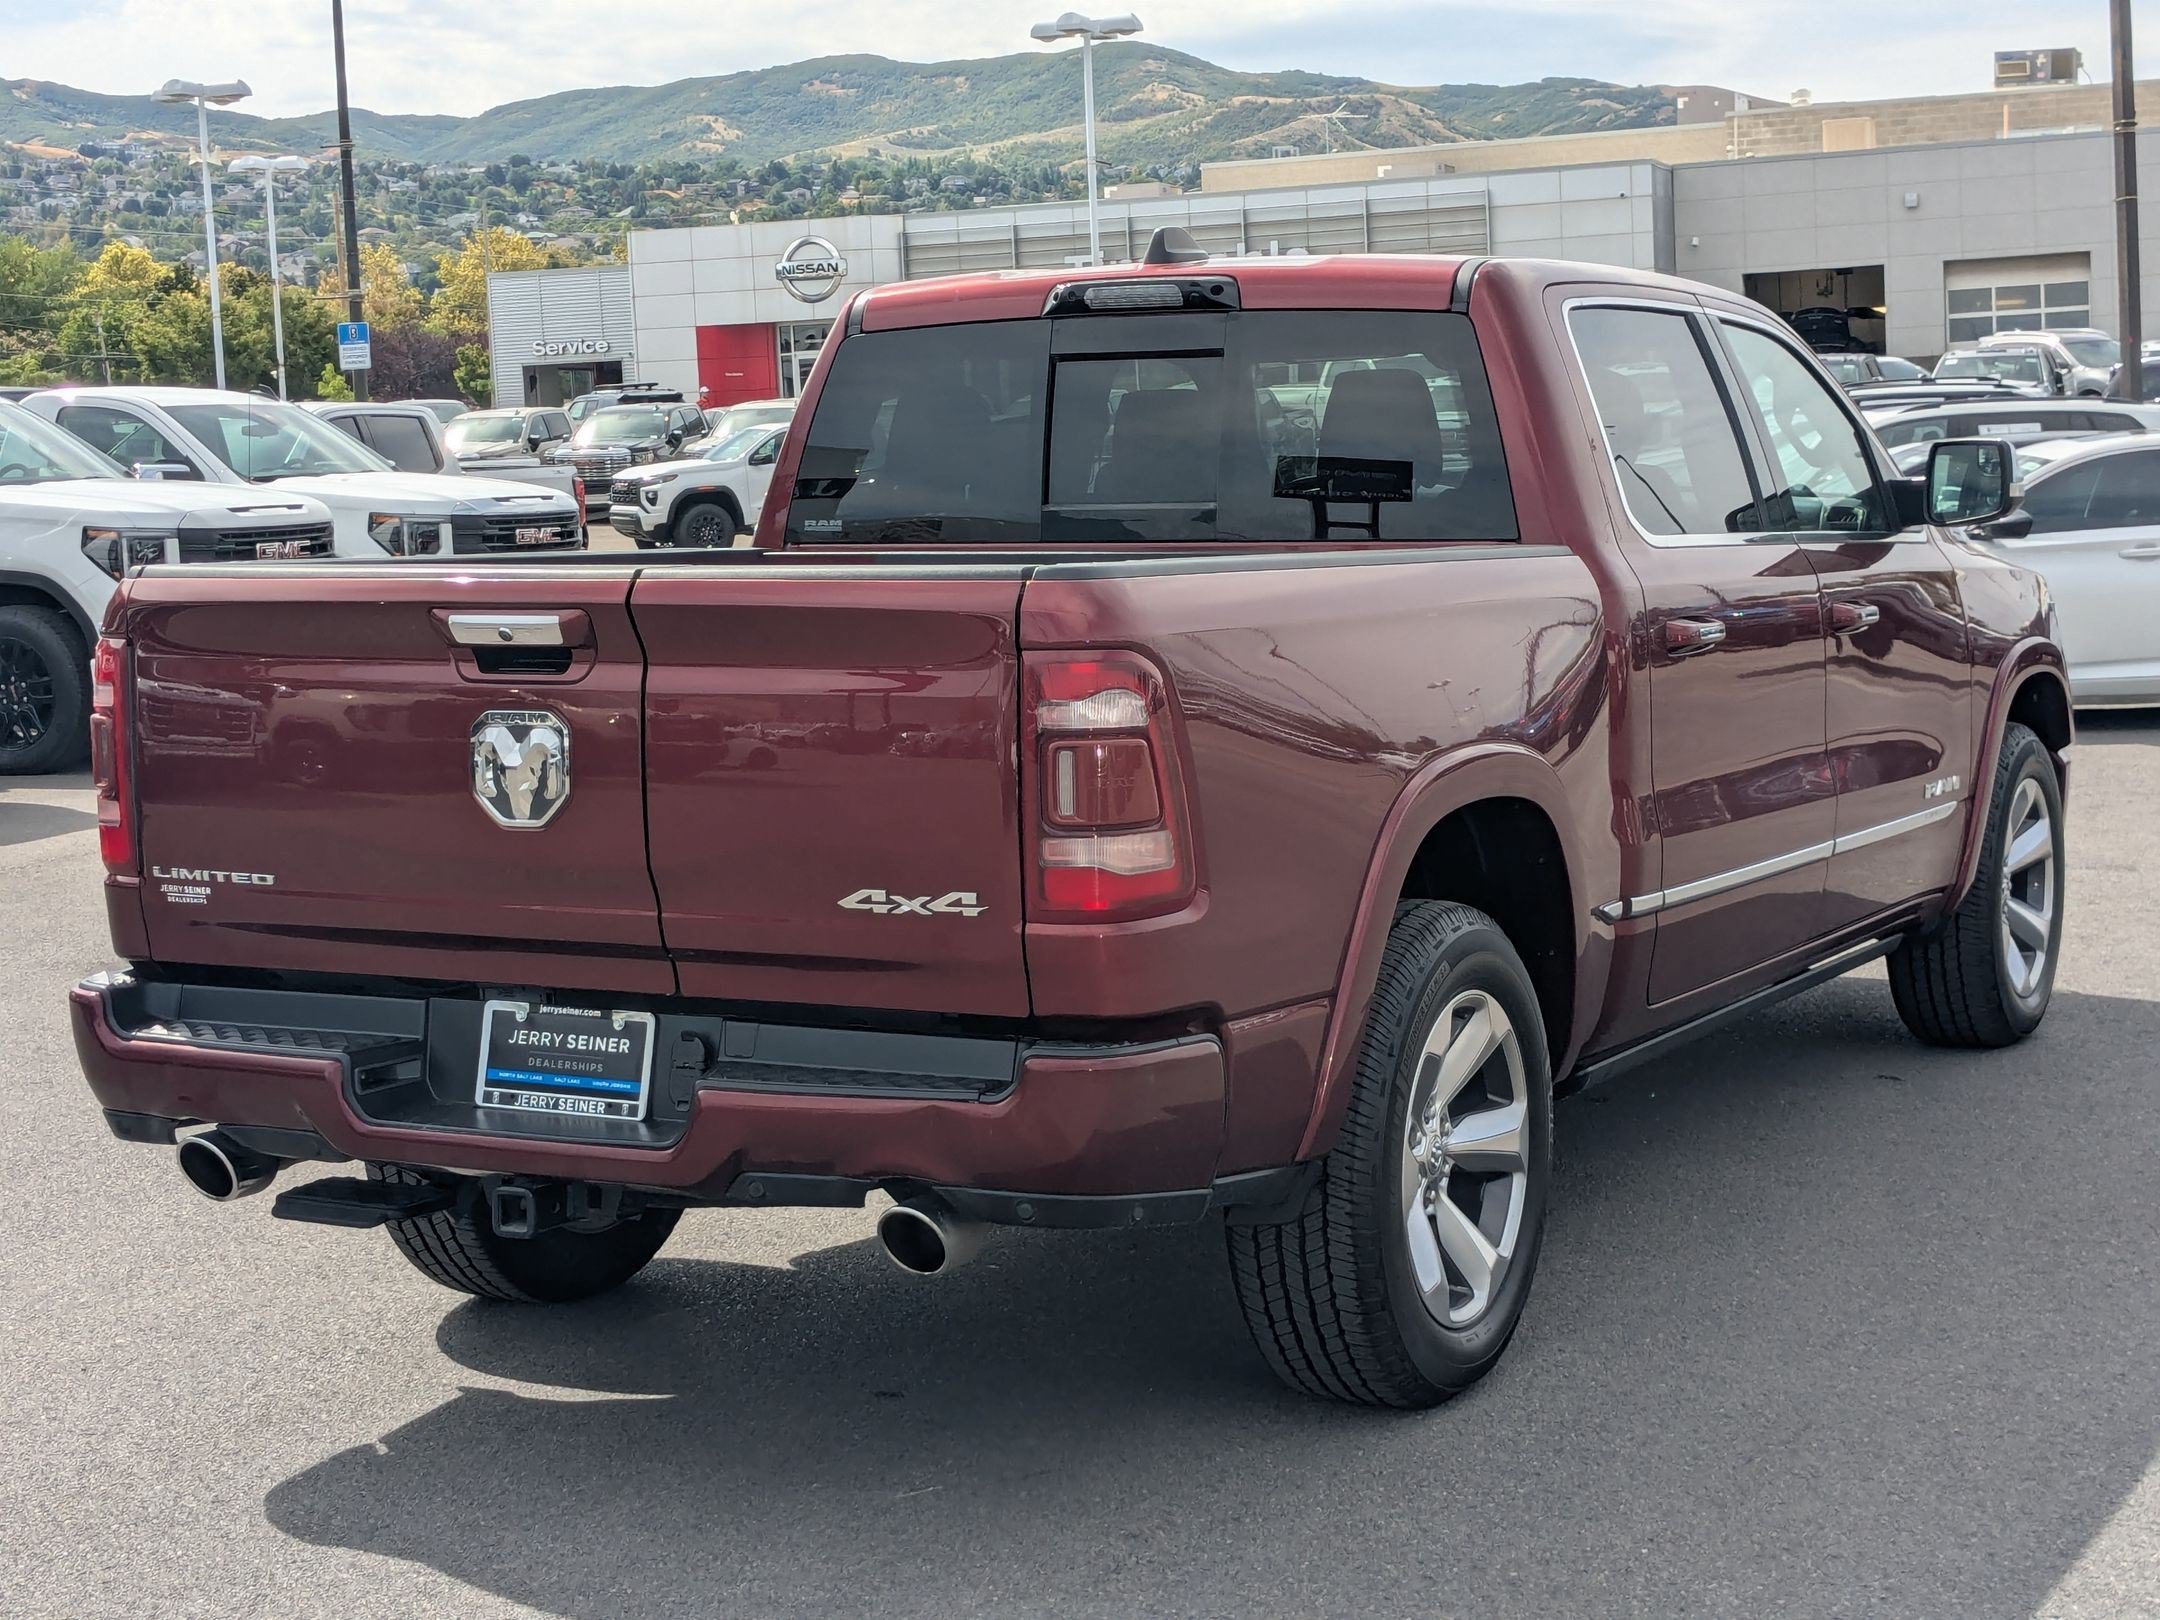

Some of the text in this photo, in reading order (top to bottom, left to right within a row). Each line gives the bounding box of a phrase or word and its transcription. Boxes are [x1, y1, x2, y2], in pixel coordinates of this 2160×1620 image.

[782, 262, 839, 275] NISSAN
[532, 339, 610, 356] Service
[804, 519, 843, 527] RAM
[515, 527, 561, 544] GMC
[256, 540, 311, 560] GMC
[487, 713, 554, 724] RAM
[152, 866, 275, 886] LIMITED
[160, 884, 212, 895] JERRY SEINER
[837, 889, 989, 917] 4x4
[539, 1003, 602, 1017] jerryseiner.com
[508, 1029, 631, 1054] JERRY SEINER
[528, 1057, 604, 1073] DEALERSHIPS
[514, 1094, 557, 1109] JERRY
[558, 1098, 606, 1114] SEINER
